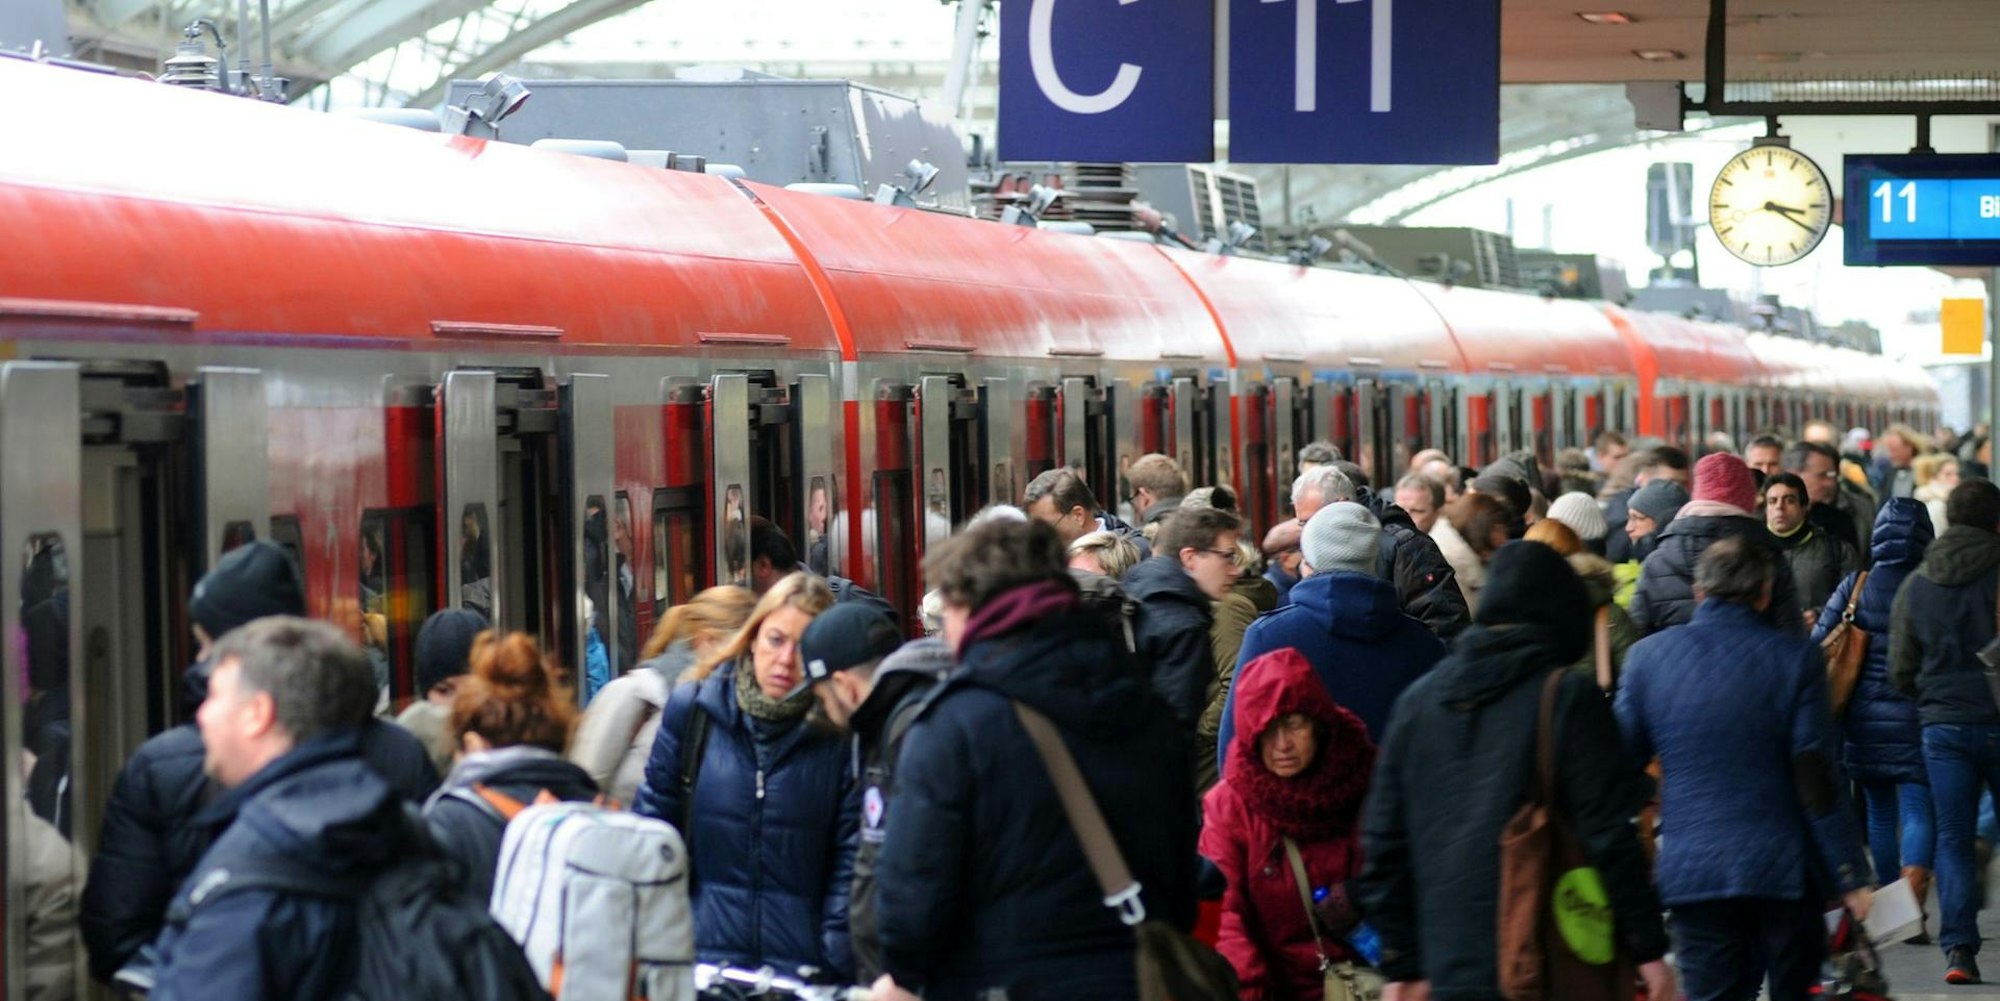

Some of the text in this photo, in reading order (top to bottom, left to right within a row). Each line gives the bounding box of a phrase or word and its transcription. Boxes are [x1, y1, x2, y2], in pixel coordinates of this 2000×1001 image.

[1029, 0, 1143, 114] C
[1260, 0, 1392, 112] 11
[1873, 181, 1917, 223] 11
